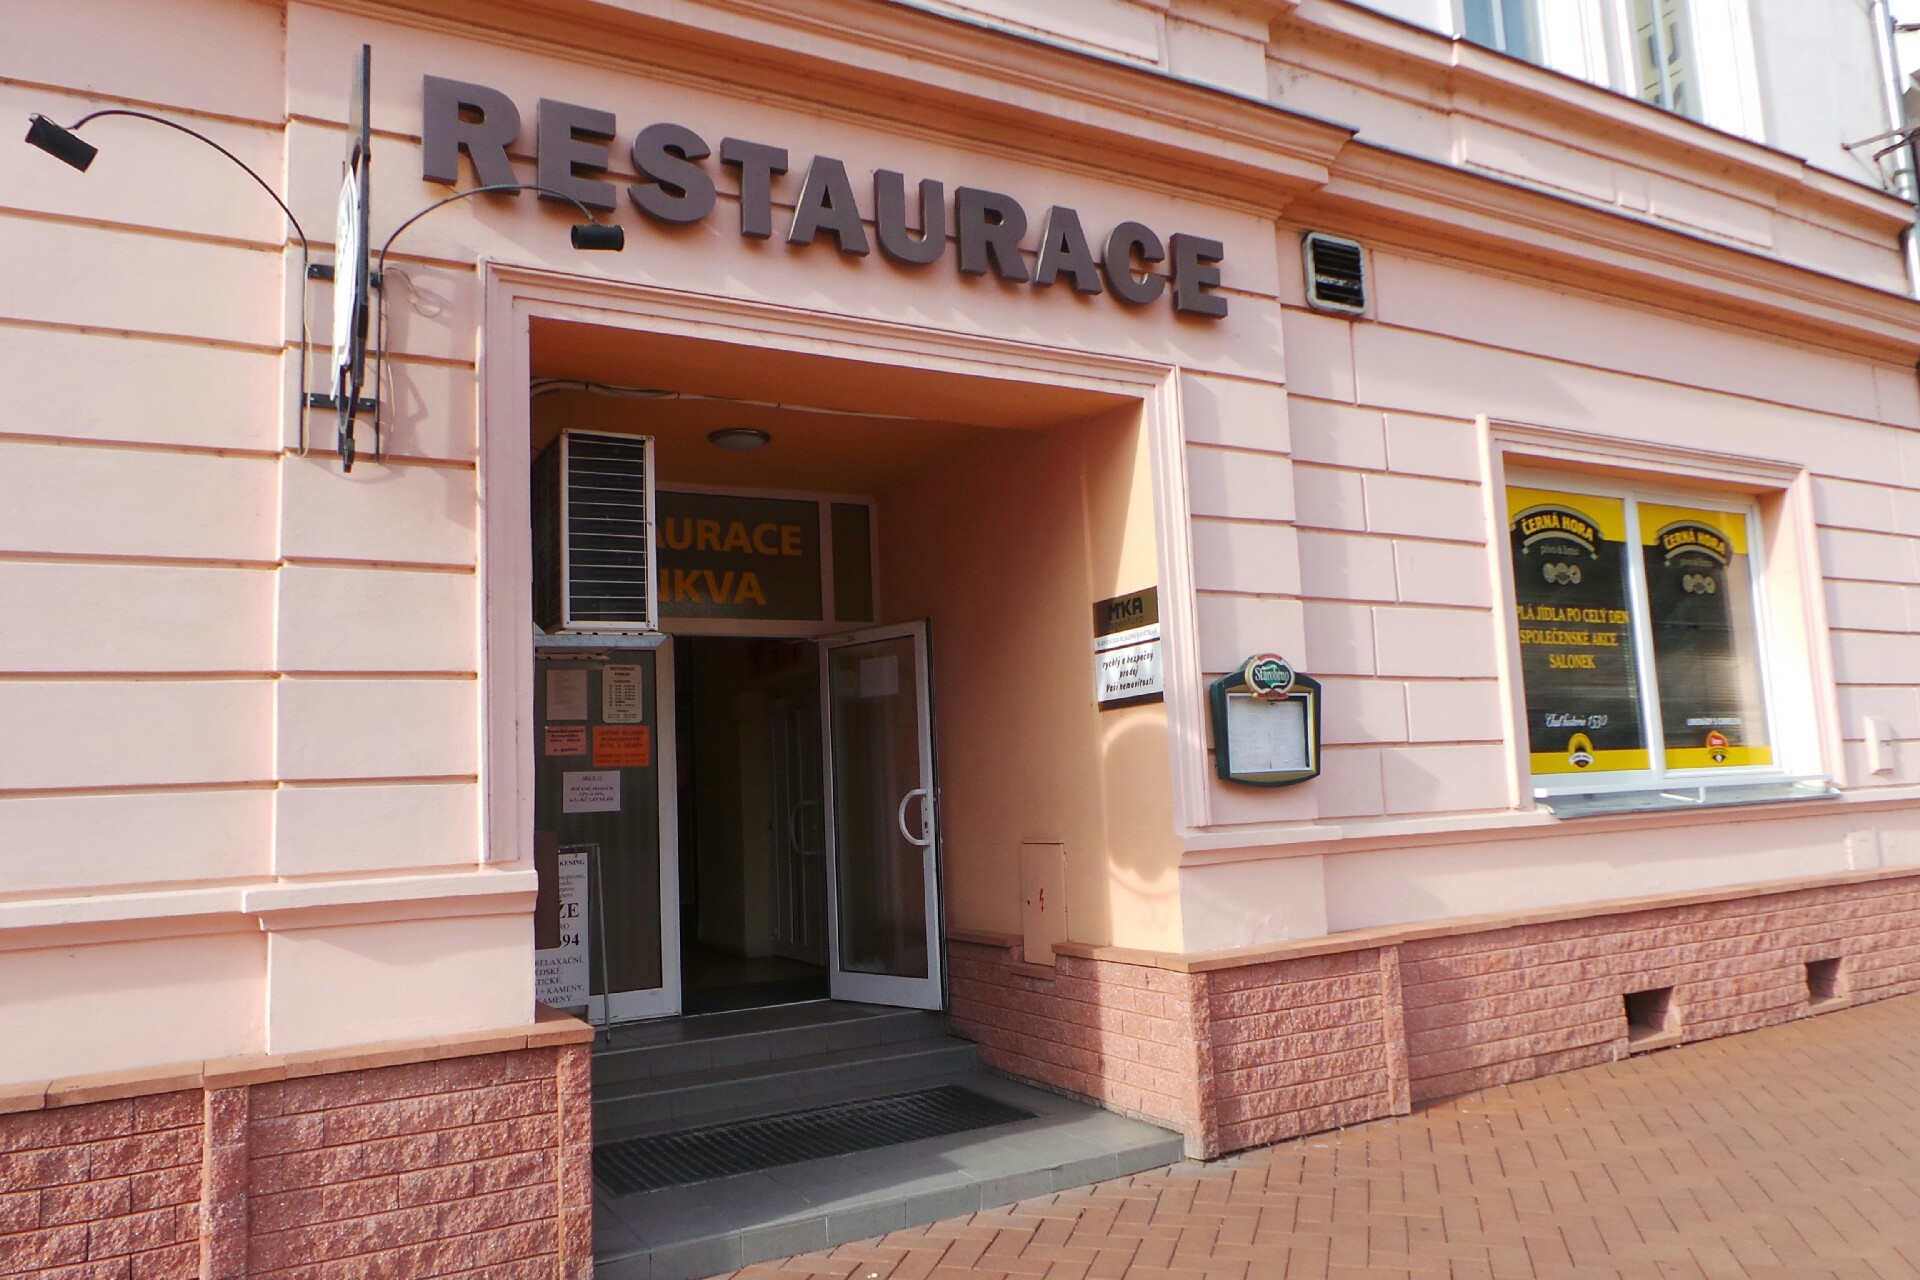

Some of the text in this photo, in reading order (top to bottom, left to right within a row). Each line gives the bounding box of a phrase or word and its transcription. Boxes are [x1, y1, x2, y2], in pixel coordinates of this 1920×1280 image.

[422, 74, 1228, 319] RESTAURACE
[1522, 512, 1594, 542] ČERNÁ HORA
[1108, 597, 1143, 621] MKA
[1537, 604, 1566, 620] JÍDLA
[1566, 607, 1581, 621] PO
[1583, 607, 1606, 623] CELÝ
[1520, 628, 1619, 646] SPOLEČENSKÉ AKCE
[1102, 655, 1120, 671] rychlý
[1126, 650, 1153, 664] bezpečný
[1549, 654, 1596, 668] SALONEK
[1119, 665, 1138, 680] prodej
[1255, 666, 1289, 682] Starobrno
[560, 933, 579, 948] 94
[535, 977, 563, 986] TICKÉ,
